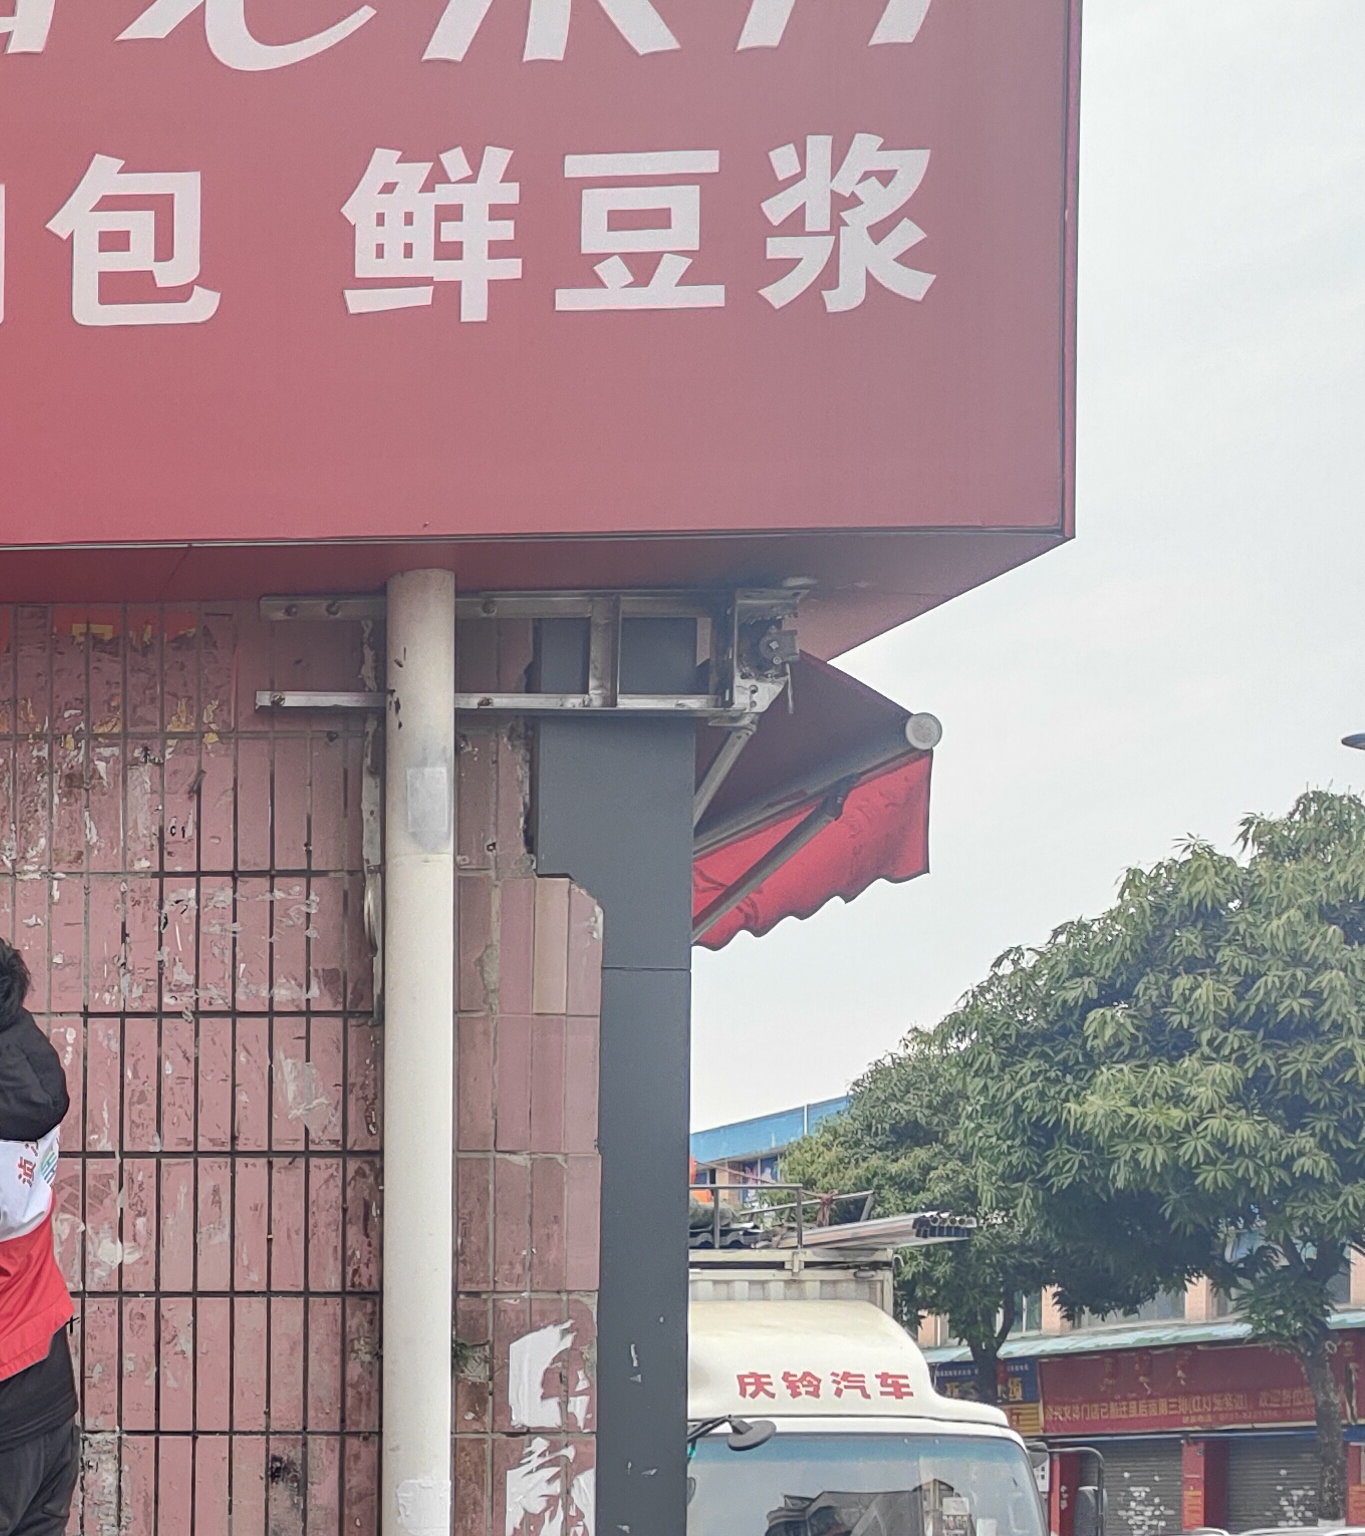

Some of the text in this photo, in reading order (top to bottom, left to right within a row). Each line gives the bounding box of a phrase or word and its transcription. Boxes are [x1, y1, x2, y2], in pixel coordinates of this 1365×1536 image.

[340, 132, 940, 322] 鲜豆浆
[736, 1370, 915, 1400] 庆铃汽车
